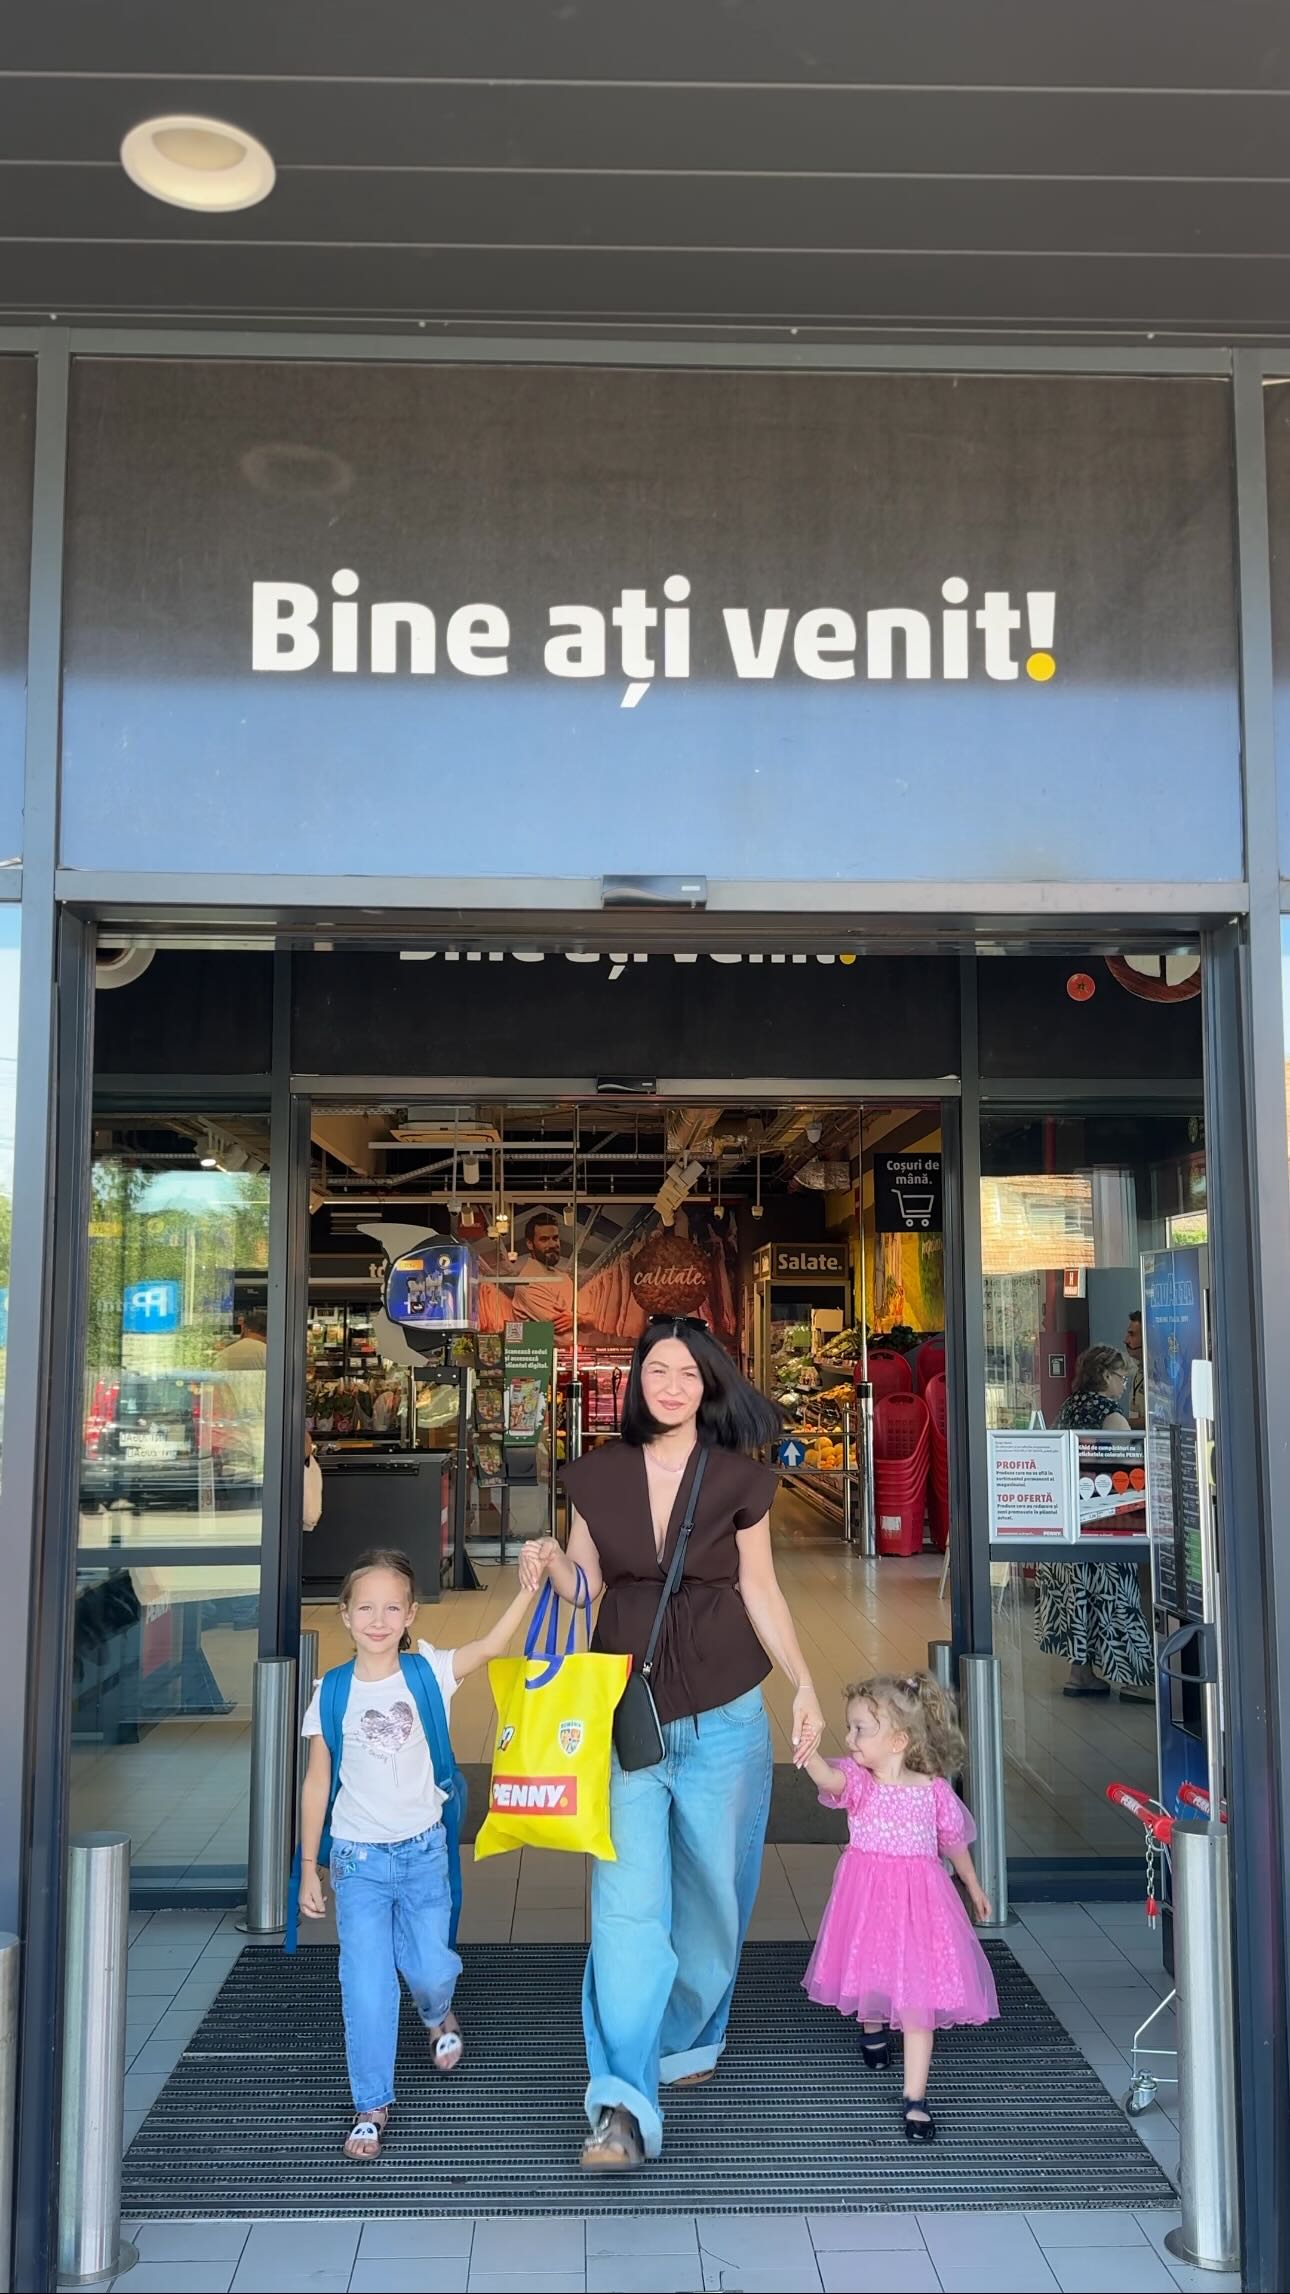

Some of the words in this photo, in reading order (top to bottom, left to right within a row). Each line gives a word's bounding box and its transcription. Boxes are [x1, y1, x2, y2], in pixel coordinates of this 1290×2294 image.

[252, 569, 510, 676] Bine
[543, 574, 690, 708] ați
[723, 577, 1056, 682] venit!
[886, 1158, 922, 1173] Coșuri
[924, 1159, 940, 1170] de
[895, 1173, 933, 1184] mână.
[778, 1253, 842, 1270] Salate.
[633, 1265, 706, 1286] calitate.
[996, 1459, 1036, 1469] PROFITĂ
[996, 1494, 1015, 1502] TOP
[1017, 1492, 1053, 1502] OFERTĂ
